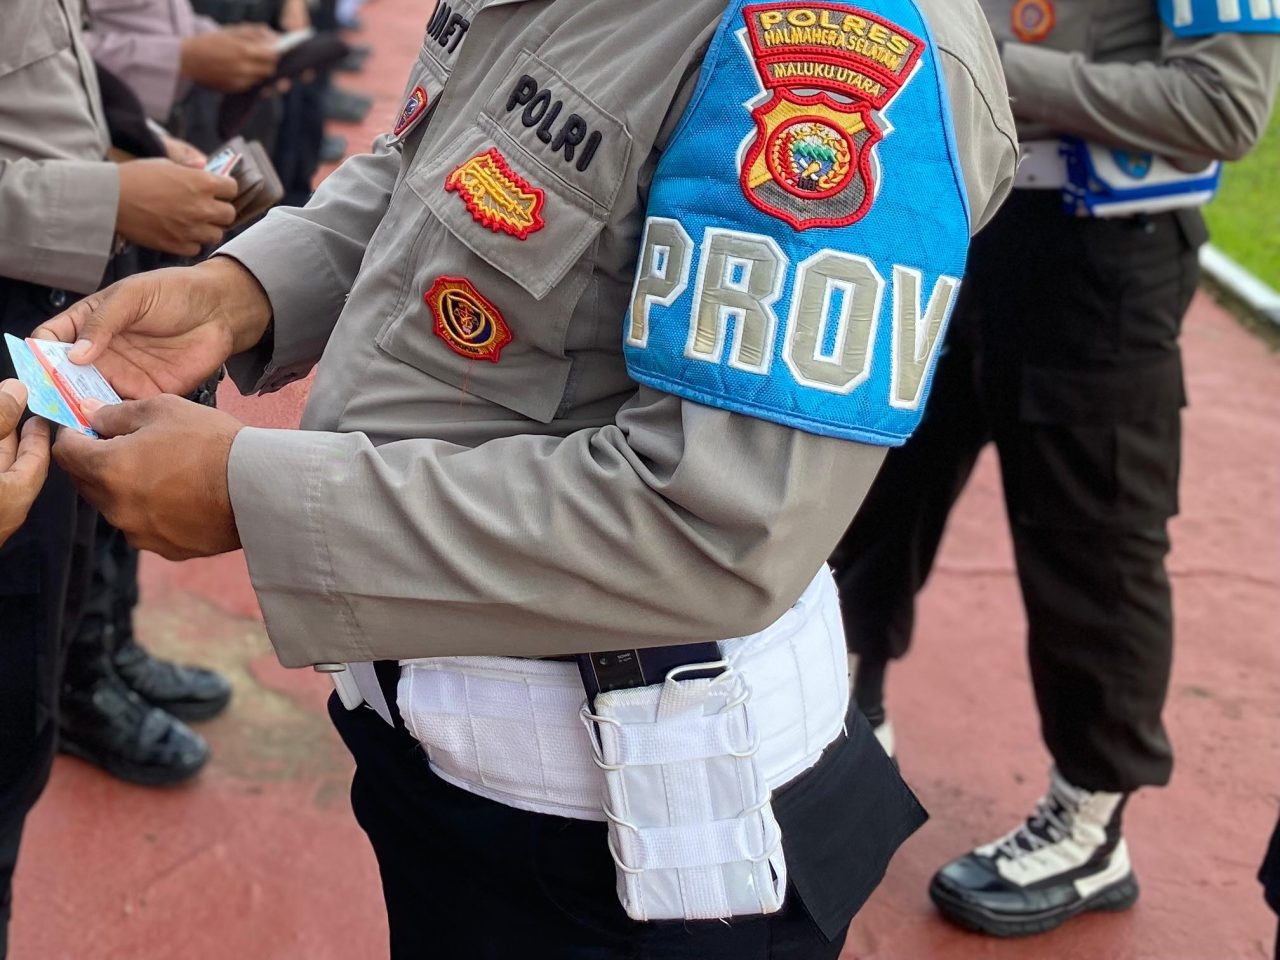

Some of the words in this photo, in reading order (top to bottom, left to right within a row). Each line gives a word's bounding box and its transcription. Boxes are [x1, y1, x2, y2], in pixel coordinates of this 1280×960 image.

[759, 8, 909, 55] POLRES
[763, 26, 845, 48] HALMAHERA
[846, 35, 901, 72] SELATAN
[773, 61, 835, 79] MALUKU
[836, 66, 881, 97] UTARA
[506, 74, 603, 173] POLRI
[626, 216, 961, 411] PROV
